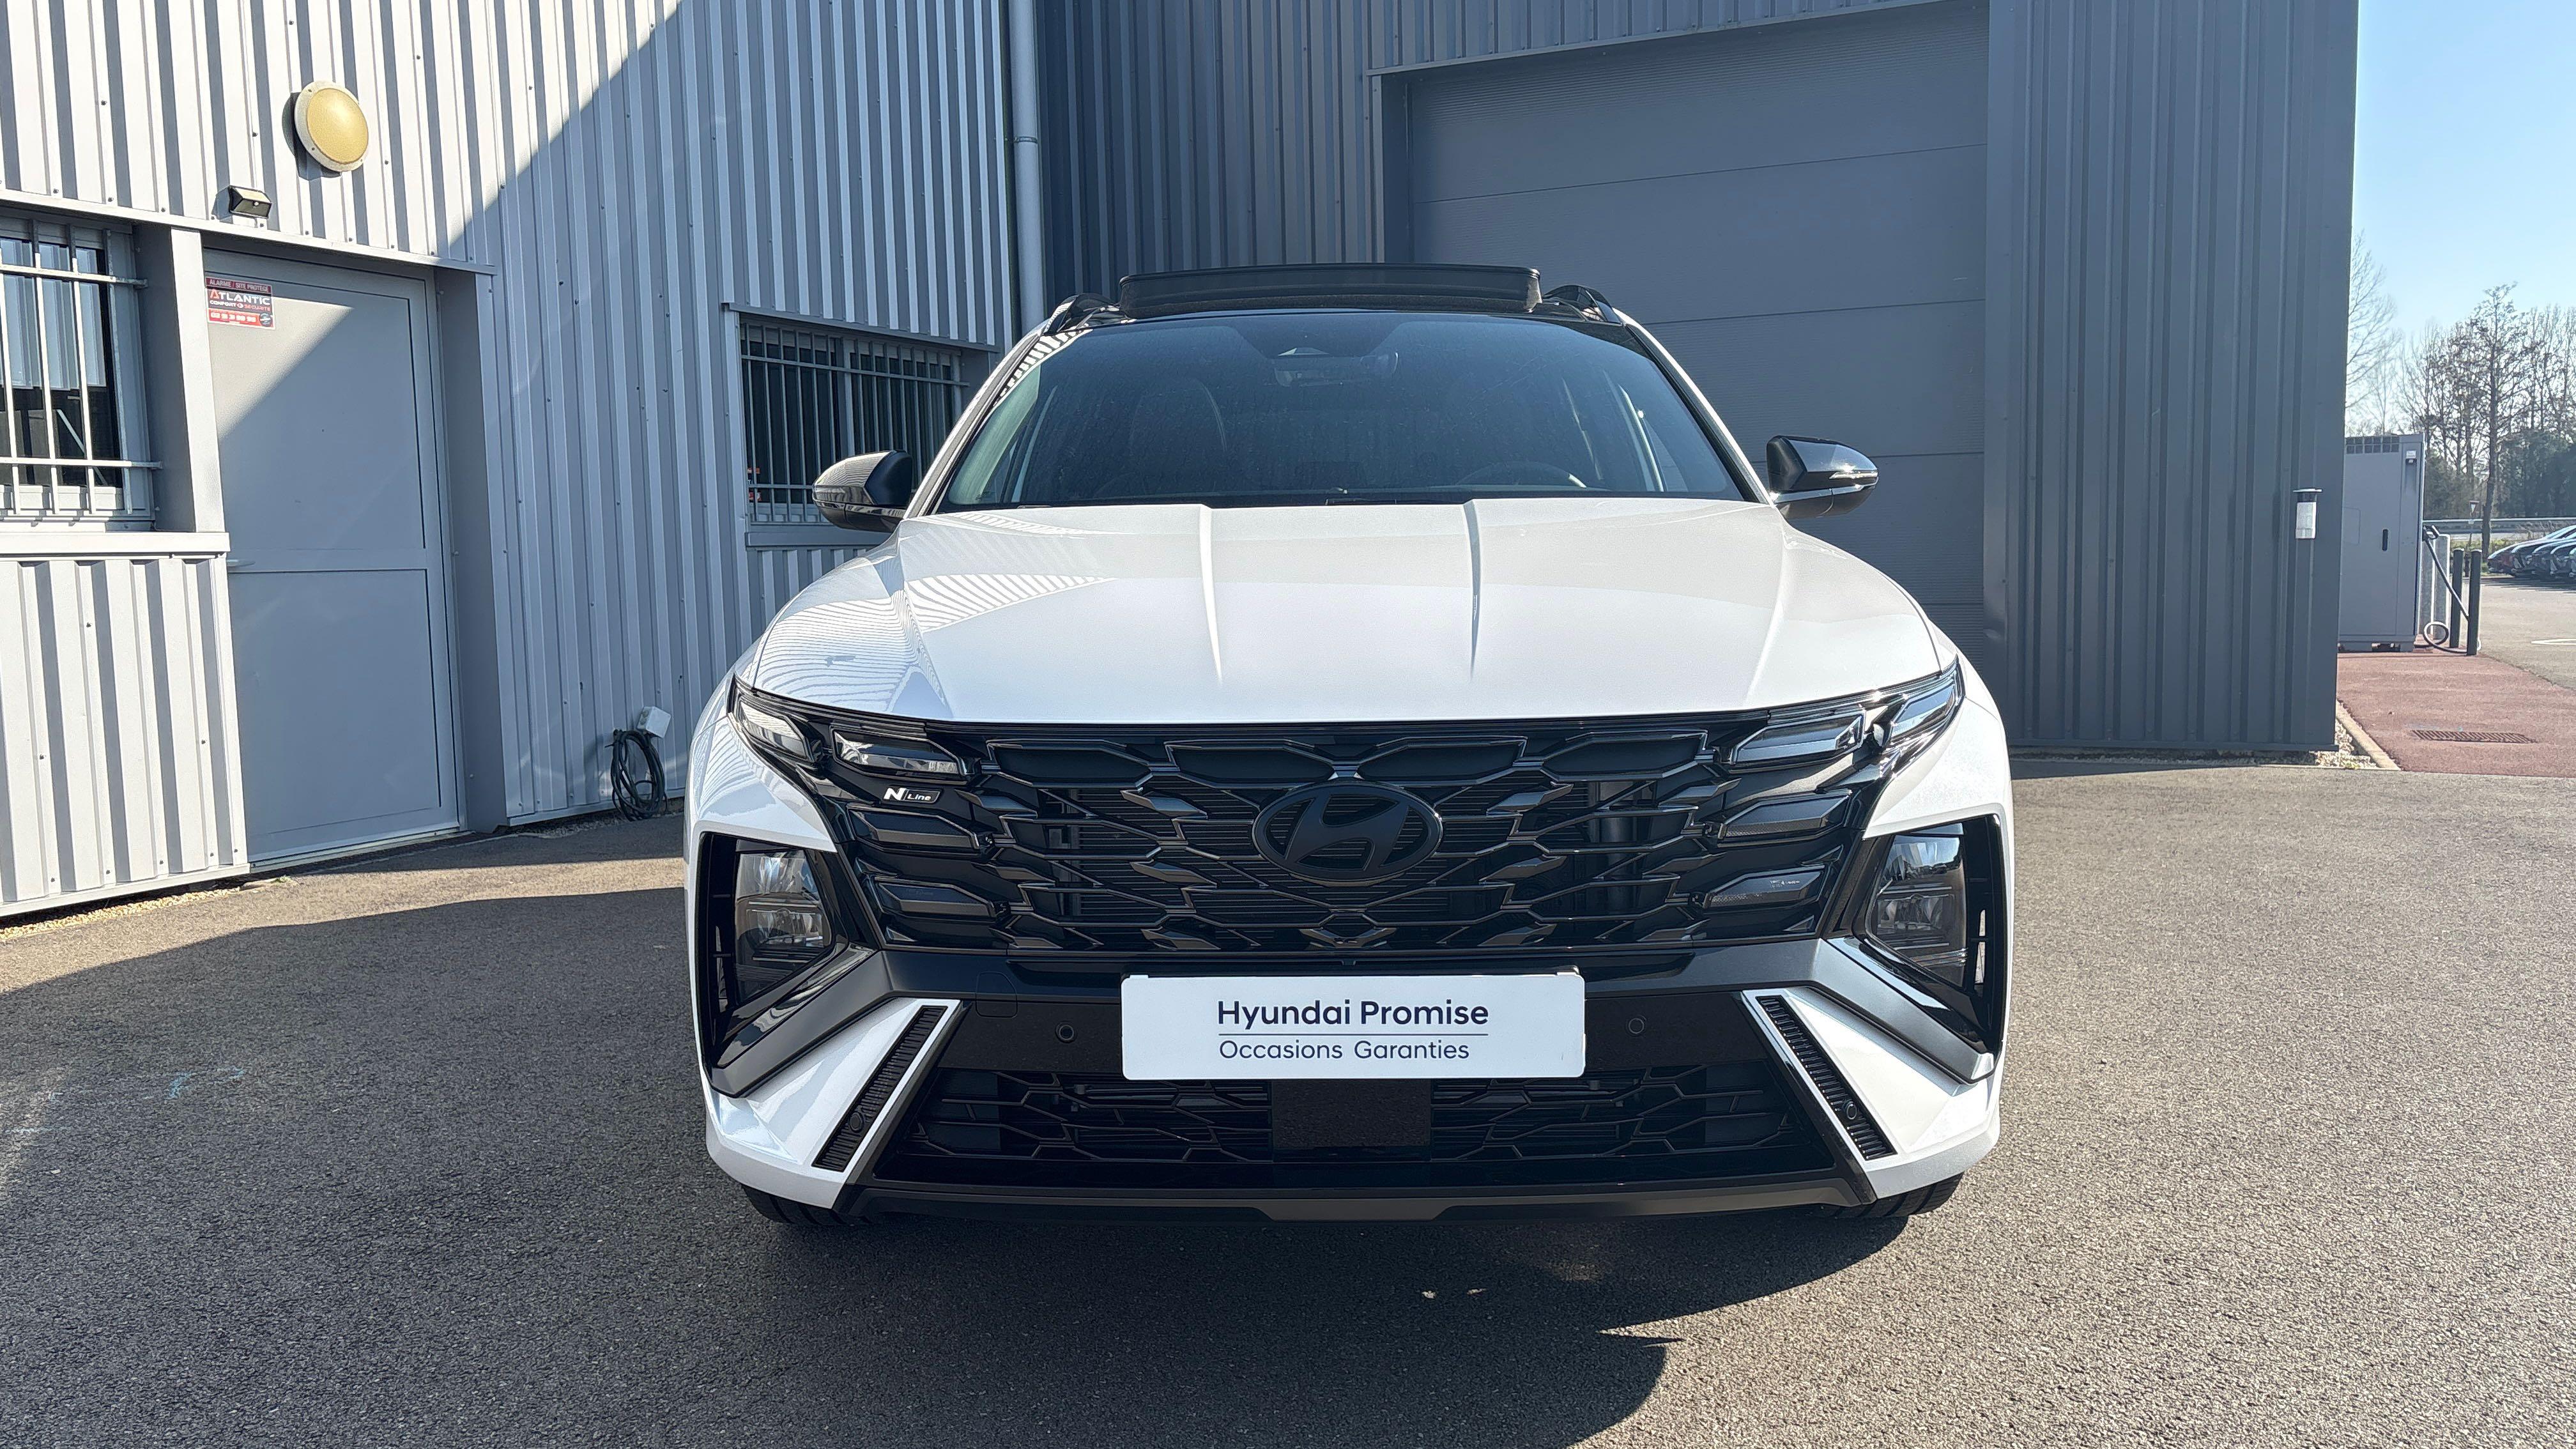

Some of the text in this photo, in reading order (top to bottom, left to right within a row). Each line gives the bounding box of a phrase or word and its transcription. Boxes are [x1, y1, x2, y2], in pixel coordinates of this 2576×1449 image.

[210, 289, 270, 305] ATLANTIC
[884, 787, 907, 801] N
[1218, 999, 1489, 1030] Hyundai Promise
[1220, 1039, 1469, 1059] Occasions Garanties
